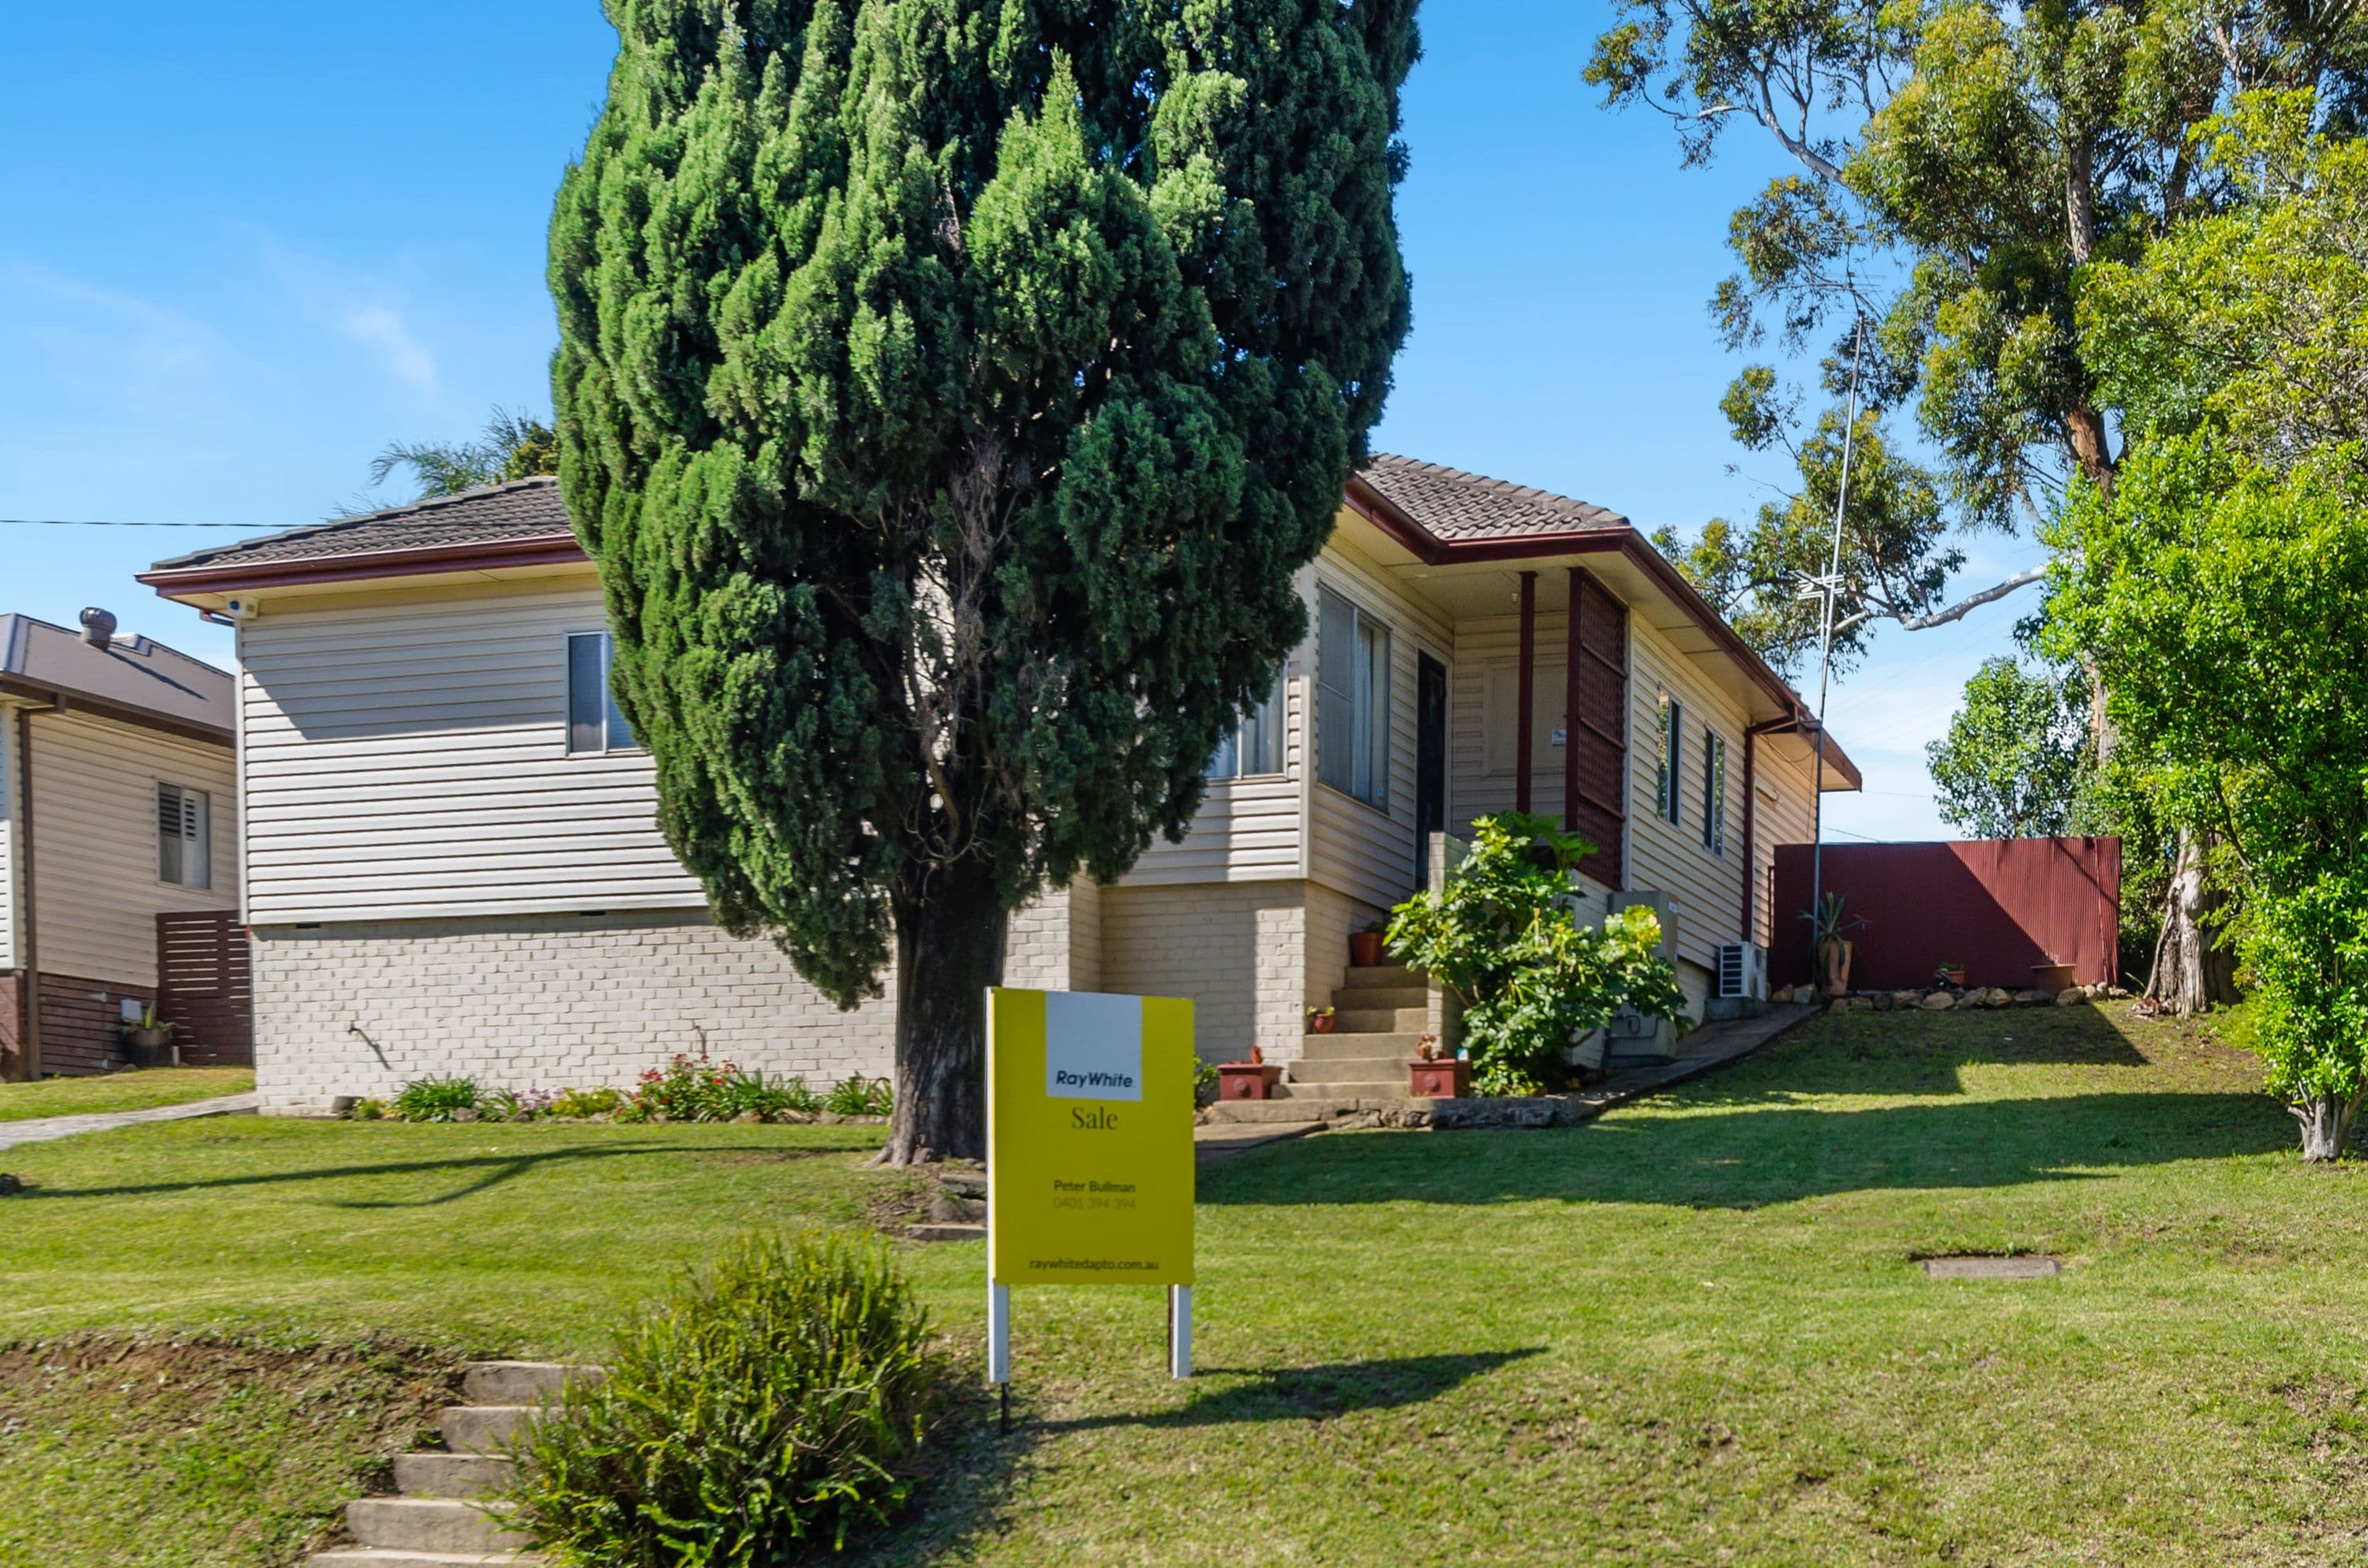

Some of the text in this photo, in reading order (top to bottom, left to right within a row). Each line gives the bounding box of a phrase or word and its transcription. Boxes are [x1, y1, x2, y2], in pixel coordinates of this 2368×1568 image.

[1071, 1106, 1118, 1130] Sale
[1054, 1180, 1086, 1192] Peter
[1029, 1258, 1160, 1271] raywhitedapto.com.au
